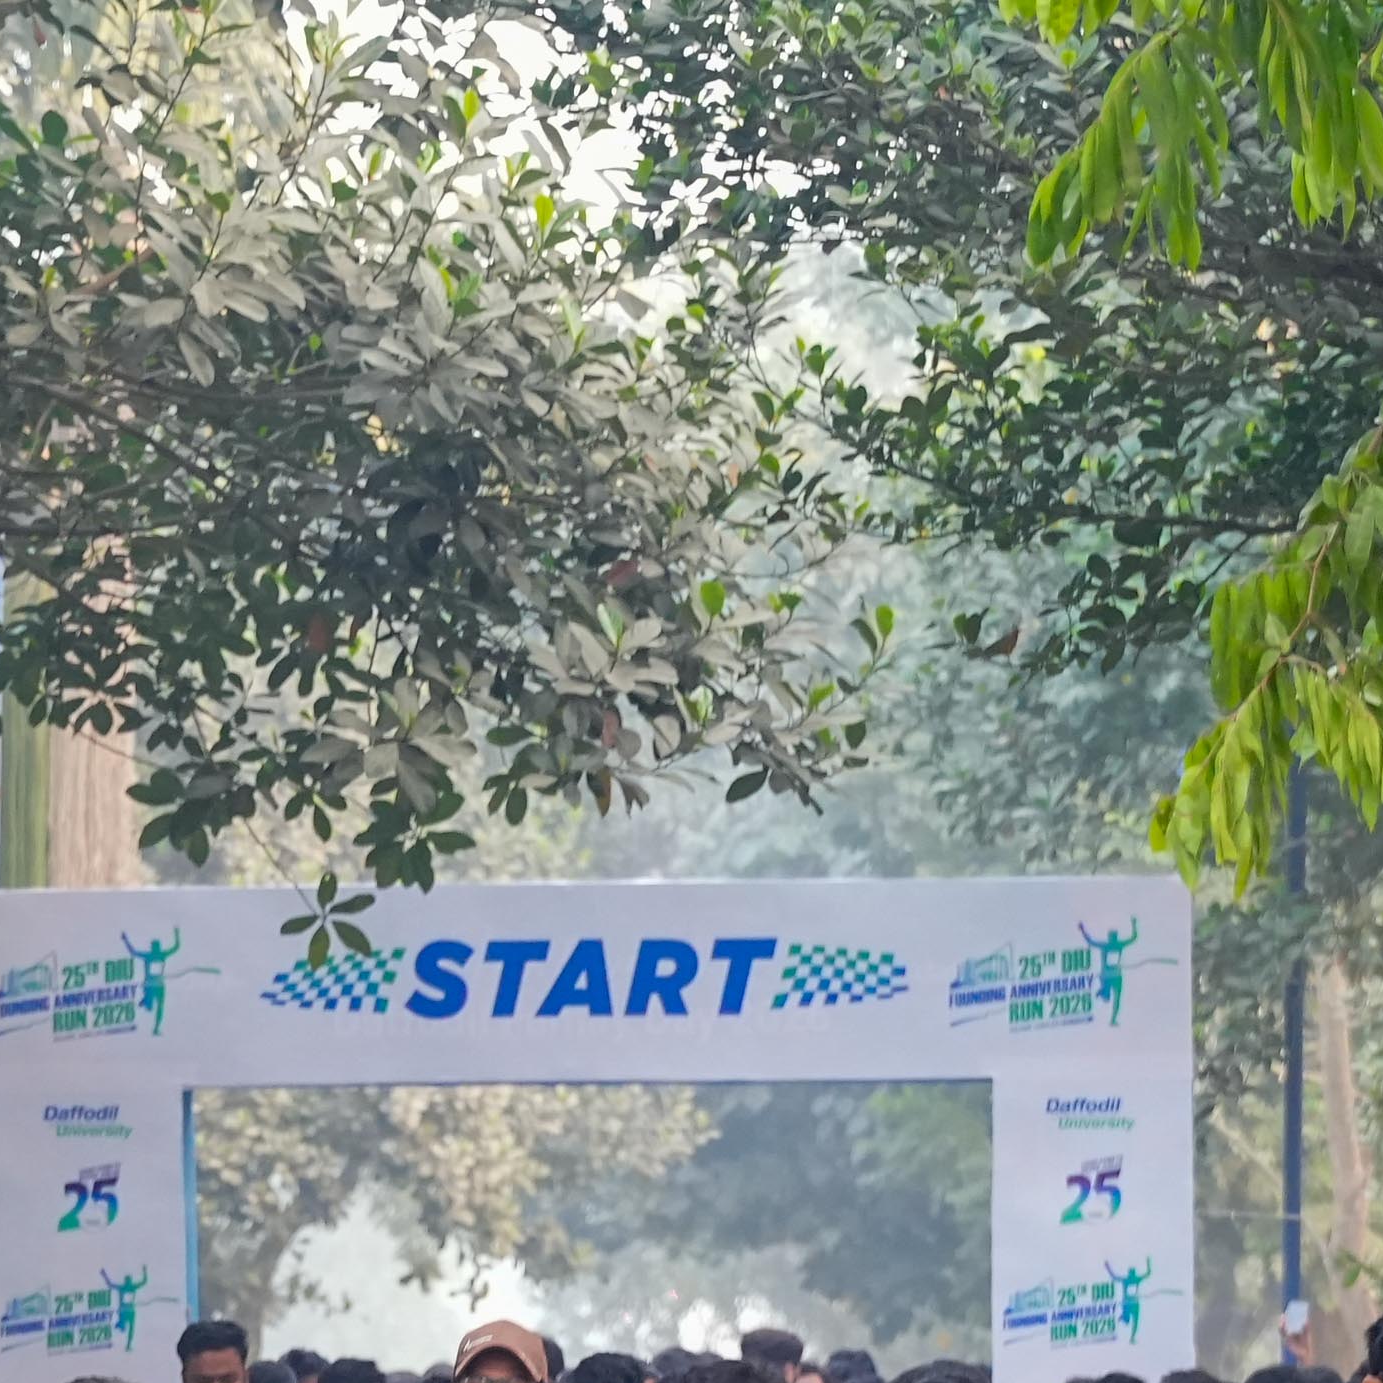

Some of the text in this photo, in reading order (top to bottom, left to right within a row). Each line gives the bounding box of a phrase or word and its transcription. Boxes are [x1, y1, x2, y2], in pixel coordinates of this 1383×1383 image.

[404, 937, 777, 1020] START
[949, 974, 1094, 1008] FOUNDING ANNIVERSARY
[54, 984, 138, 1008] ANNIVERSARY
[1009, 992, 1092, 1024] RUN 2026
[53, 1008, 87, 1033] RUN
[43, 1104, 119, 1121] Daffodil
[1046, 1096, 1121, 1113] Daffodil
[57, 1178, 119, 1232] 25
[1059, 1169, 1121, 1225] 25
